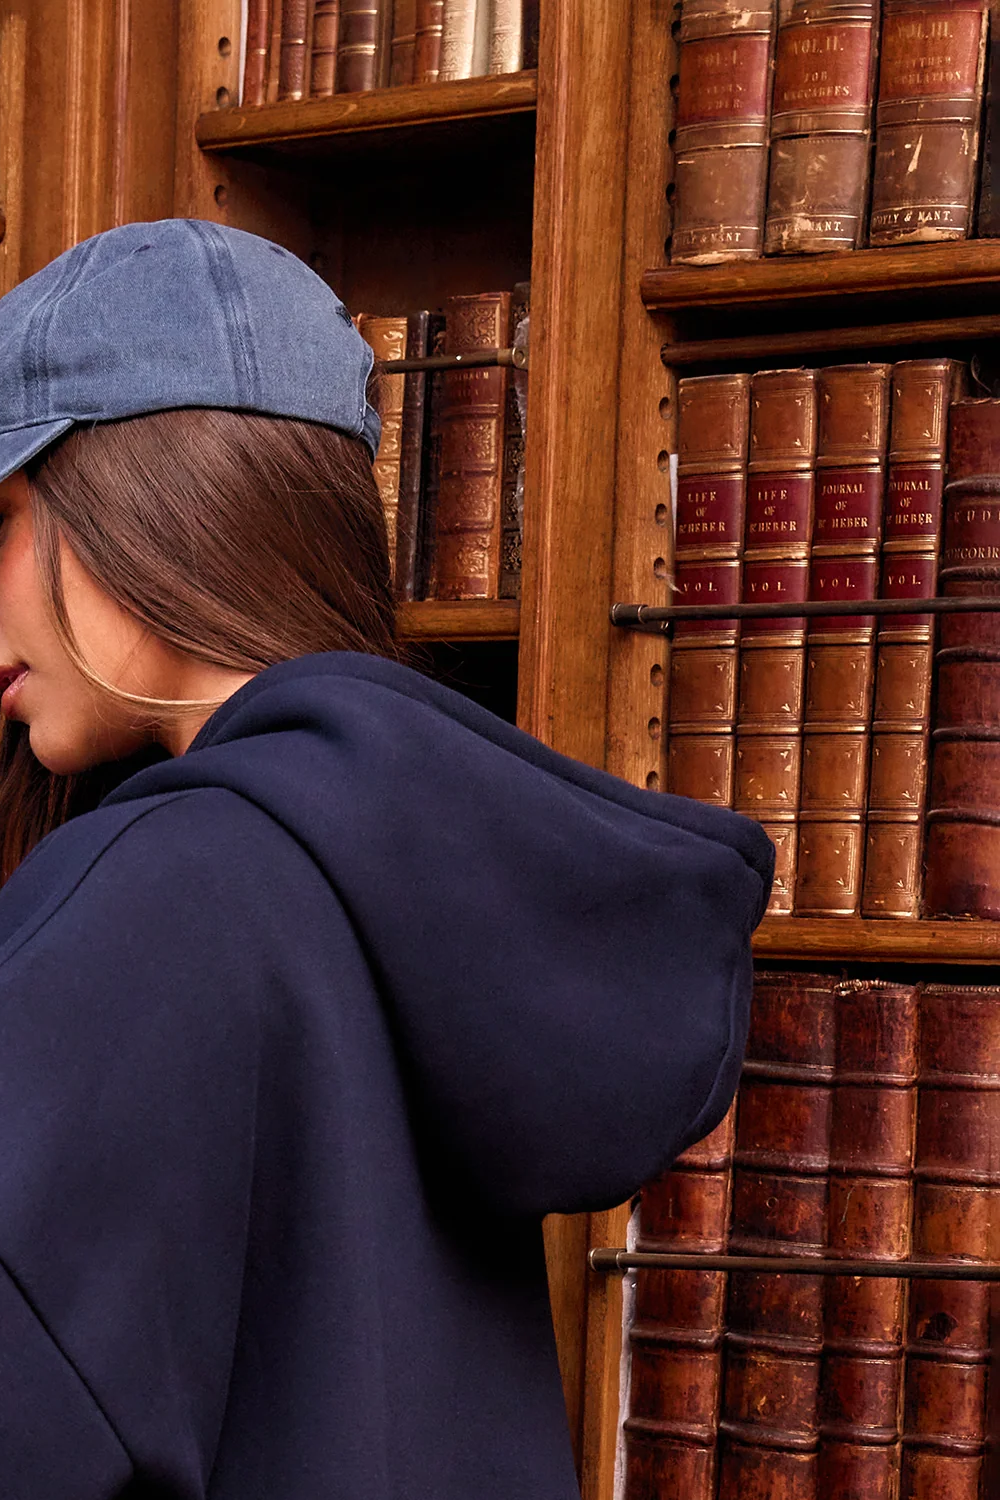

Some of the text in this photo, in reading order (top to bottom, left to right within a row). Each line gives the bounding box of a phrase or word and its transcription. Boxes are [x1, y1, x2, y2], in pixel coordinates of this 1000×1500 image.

[687, 491, 717, 503] LIFE
[757, 489, 788, 501] LIFE
[832, 517, 868, 528] HEBER
[820, 577, 855, 589] VOL.
[889, 575, 921, 586] VOL.
[683, 581, 717, 592] VOL.
[751, 581, 786, 592] VOL.
